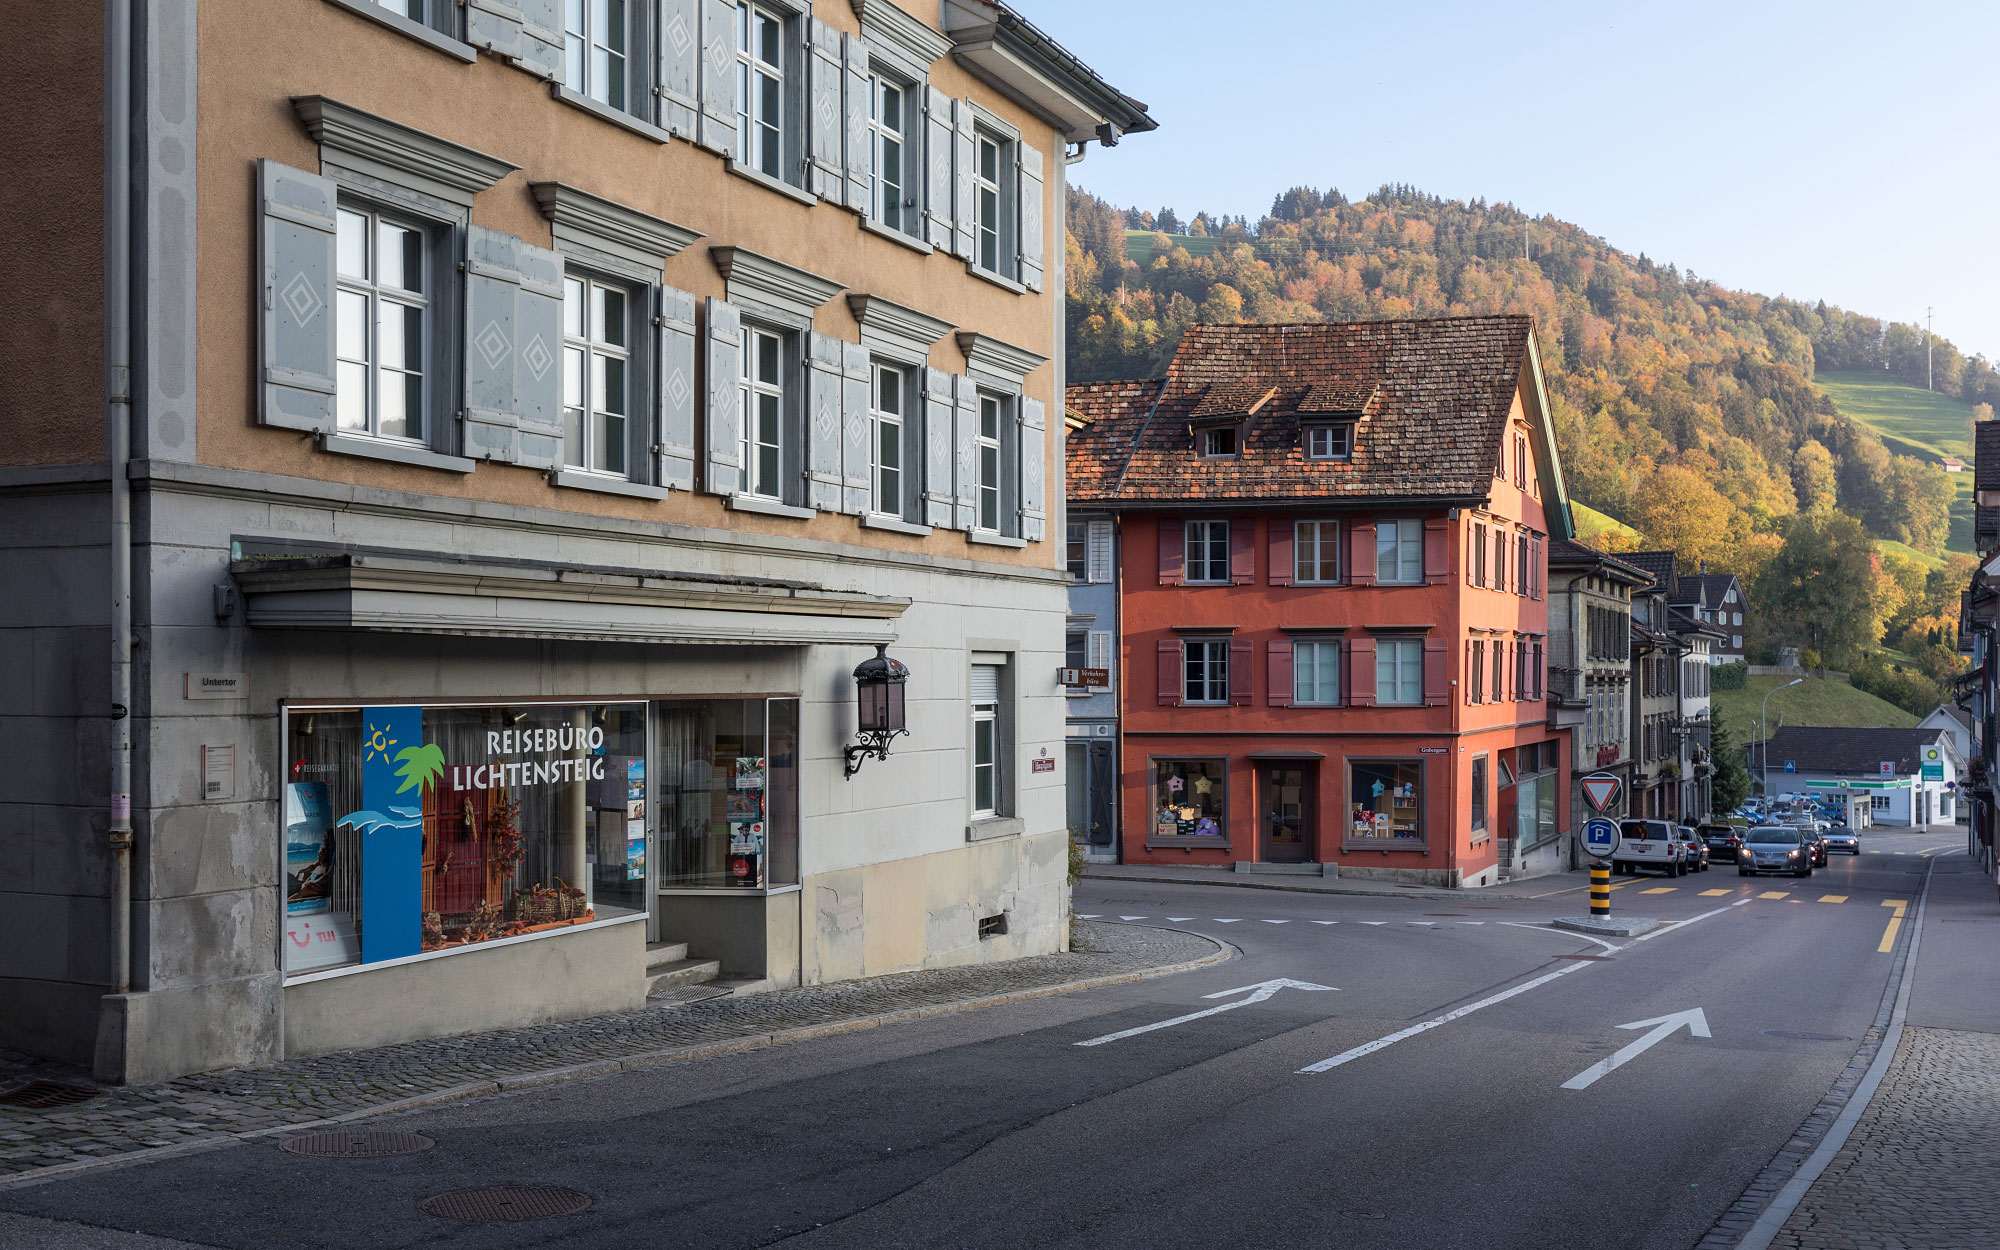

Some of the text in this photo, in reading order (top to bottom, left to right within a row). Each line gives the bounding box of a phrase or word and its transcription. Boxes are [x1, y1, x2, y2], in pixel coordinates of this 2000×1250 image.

[202, 677, 237, 686] Untertor
[1086, 677, 1100, 685] büro
[487, 722, 604, 755] REISEBÜRO
[453, 757, 605, 791] LICHTENSTEIG
[1595, 828, 1604, 841] P
[316, 930, 336, 943] TUI
